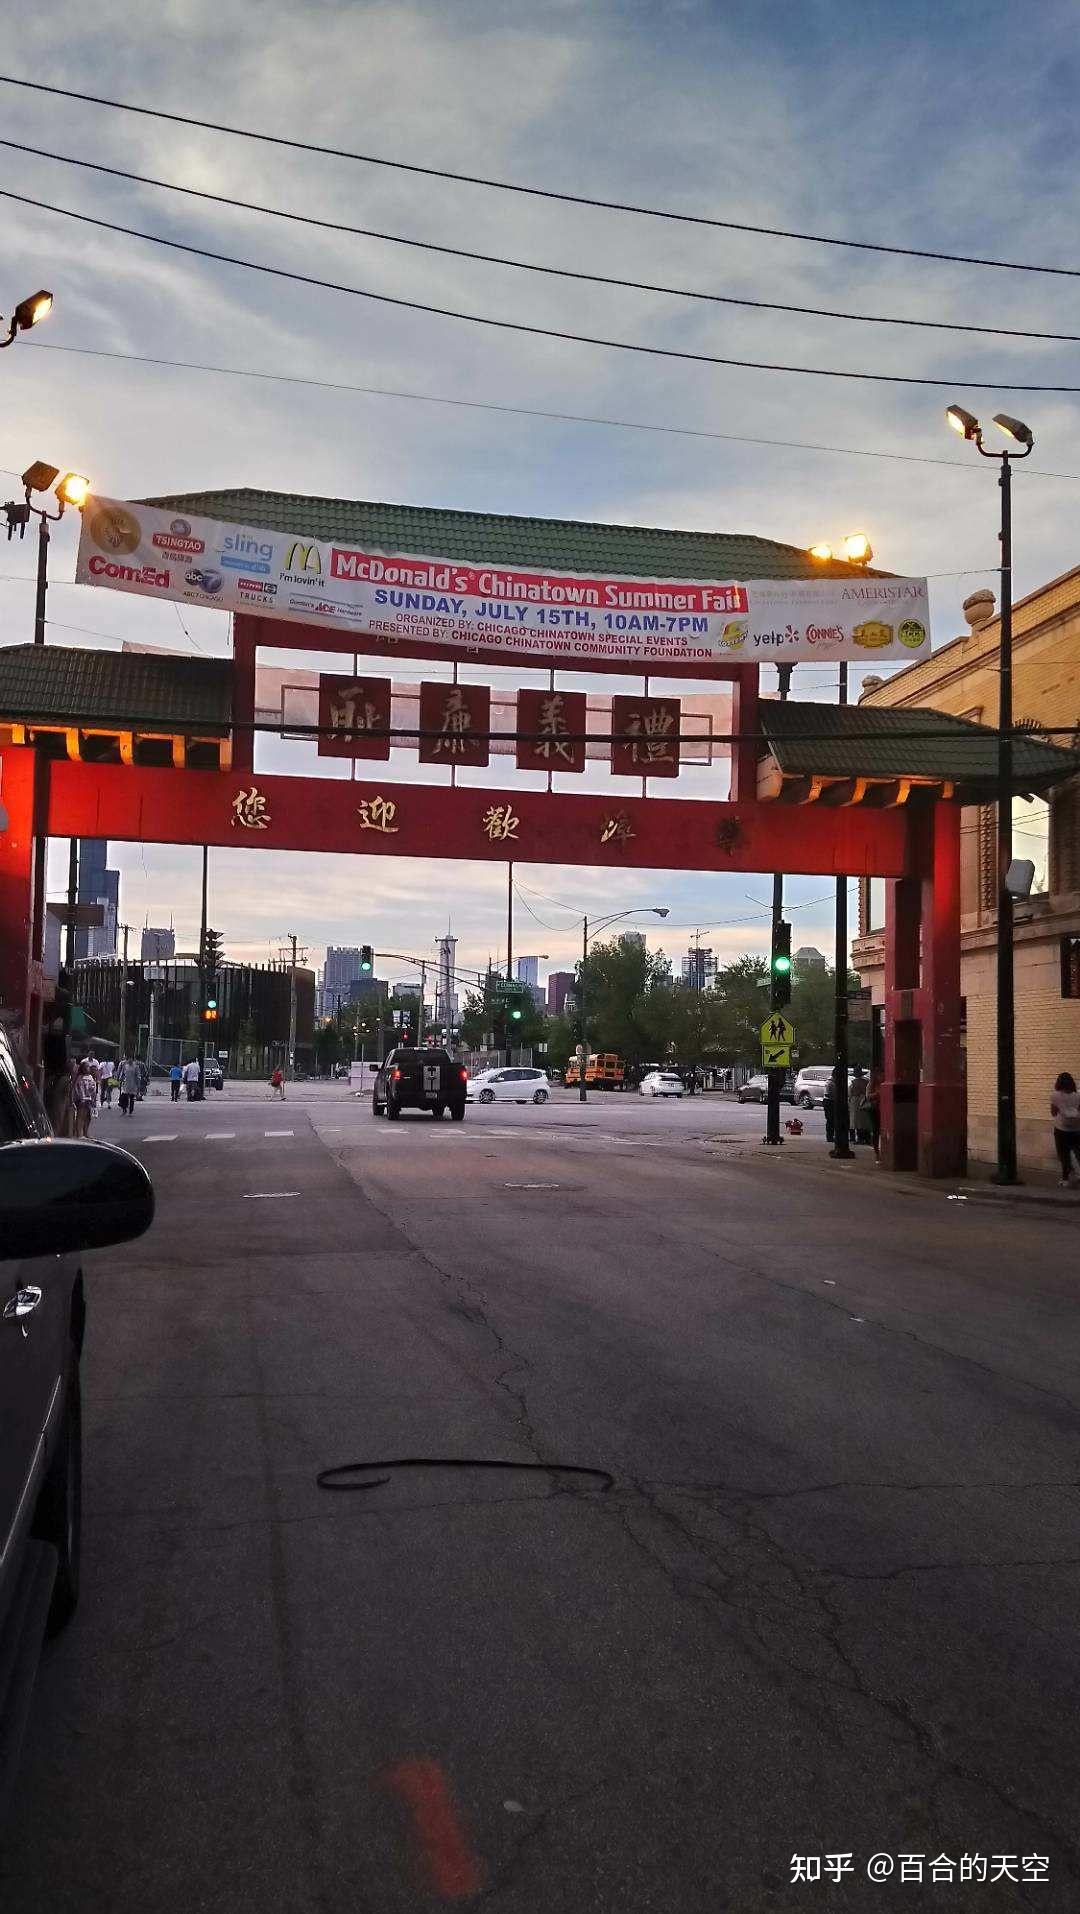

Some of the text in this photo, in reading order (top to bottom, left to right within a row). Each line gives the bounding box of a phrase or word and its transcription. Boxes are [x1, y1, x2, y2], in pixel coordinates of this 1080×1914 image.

[156, 535, 202, 551] TSINGTAO
[224, 534, 274, 561] sling
[88, 555, 171, 589] ComEd
[280, 573, 325, 587] i'm lovin' it
[336, 554, 741, 611] McDonald's Chinatown Summer Fair
[240, 591, 274, 604] TRUCKS
[841, 586, 925, 600] AMERISTAR
[375, 589, 709, 633] SUNDAY, JULY 15TH, 10AM-7PM
[369, 620, 713, 658] PRESENTED BY: CHICAGO CHINATOWN COMMUNITY FOUNDATION
[396, 613, 688, 646] ORGANIZED BY: CHICAGO CHINATOWN SPECIAL EVENTS
[754, 630, 785, 647] yelp
